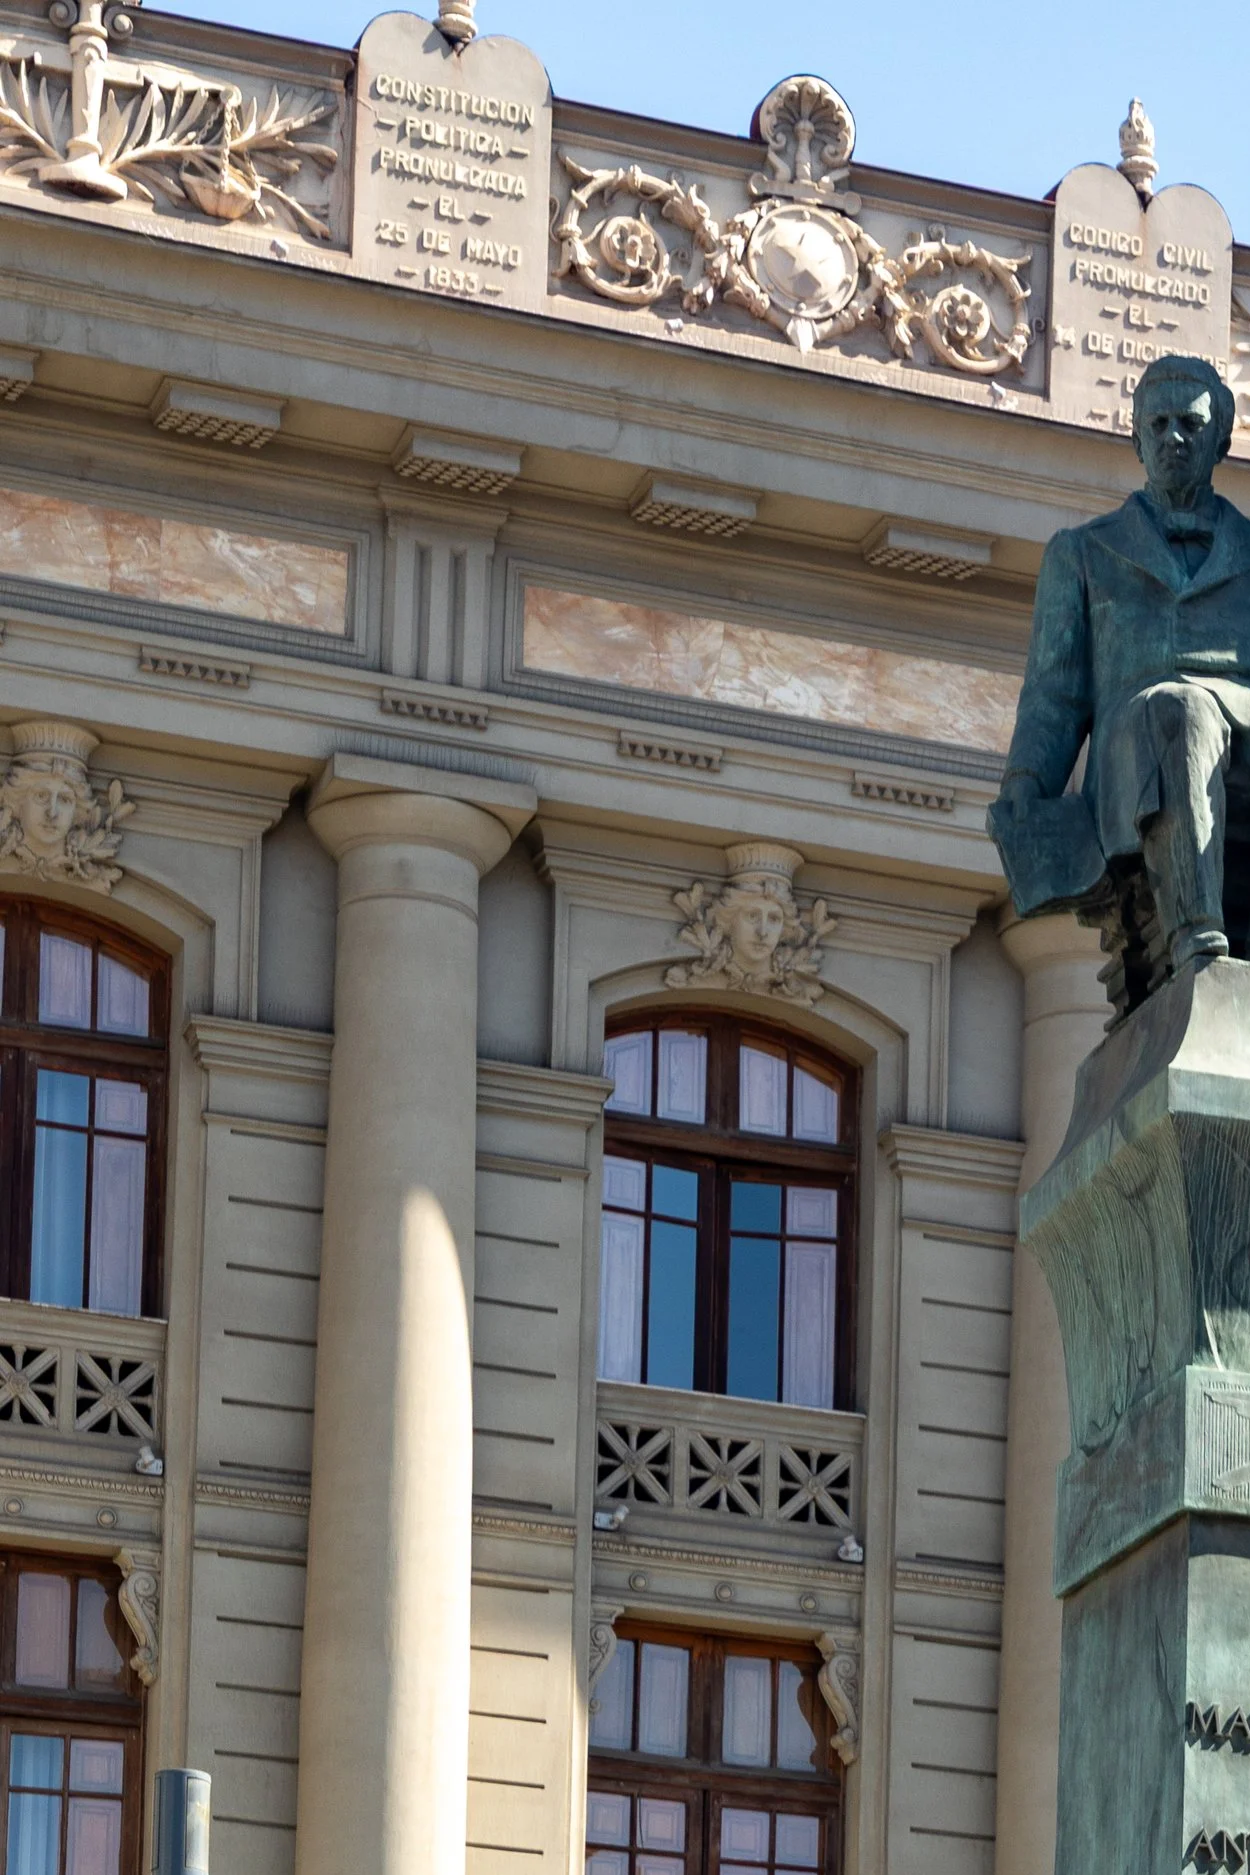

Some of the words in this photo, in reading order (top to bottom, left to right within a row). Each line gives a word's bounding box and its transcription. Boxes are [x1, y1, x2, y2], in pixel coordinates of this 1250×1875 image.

[376, 73, 535, 126] CONSTITUCION
[406, 116, 504, 157] POLITICA
[438, 196, 465, 220] EL
[378, 219, 409, 243] 25
[422, 229, 451, 253] DE
[466, 237, 522, 268] MAYO
[1069, 223, 1143, 256] CODIGO
[1163, 242, 1214, 272] CIVIL
[429, 265, 479, 294] 1833
[1075, 259, 1210, 305] PROMULGADO
[1129, 305, 1154, 328] EL
[1054, 324, 1076, 347] 14
[1087, 331, 1114, 354] DE
